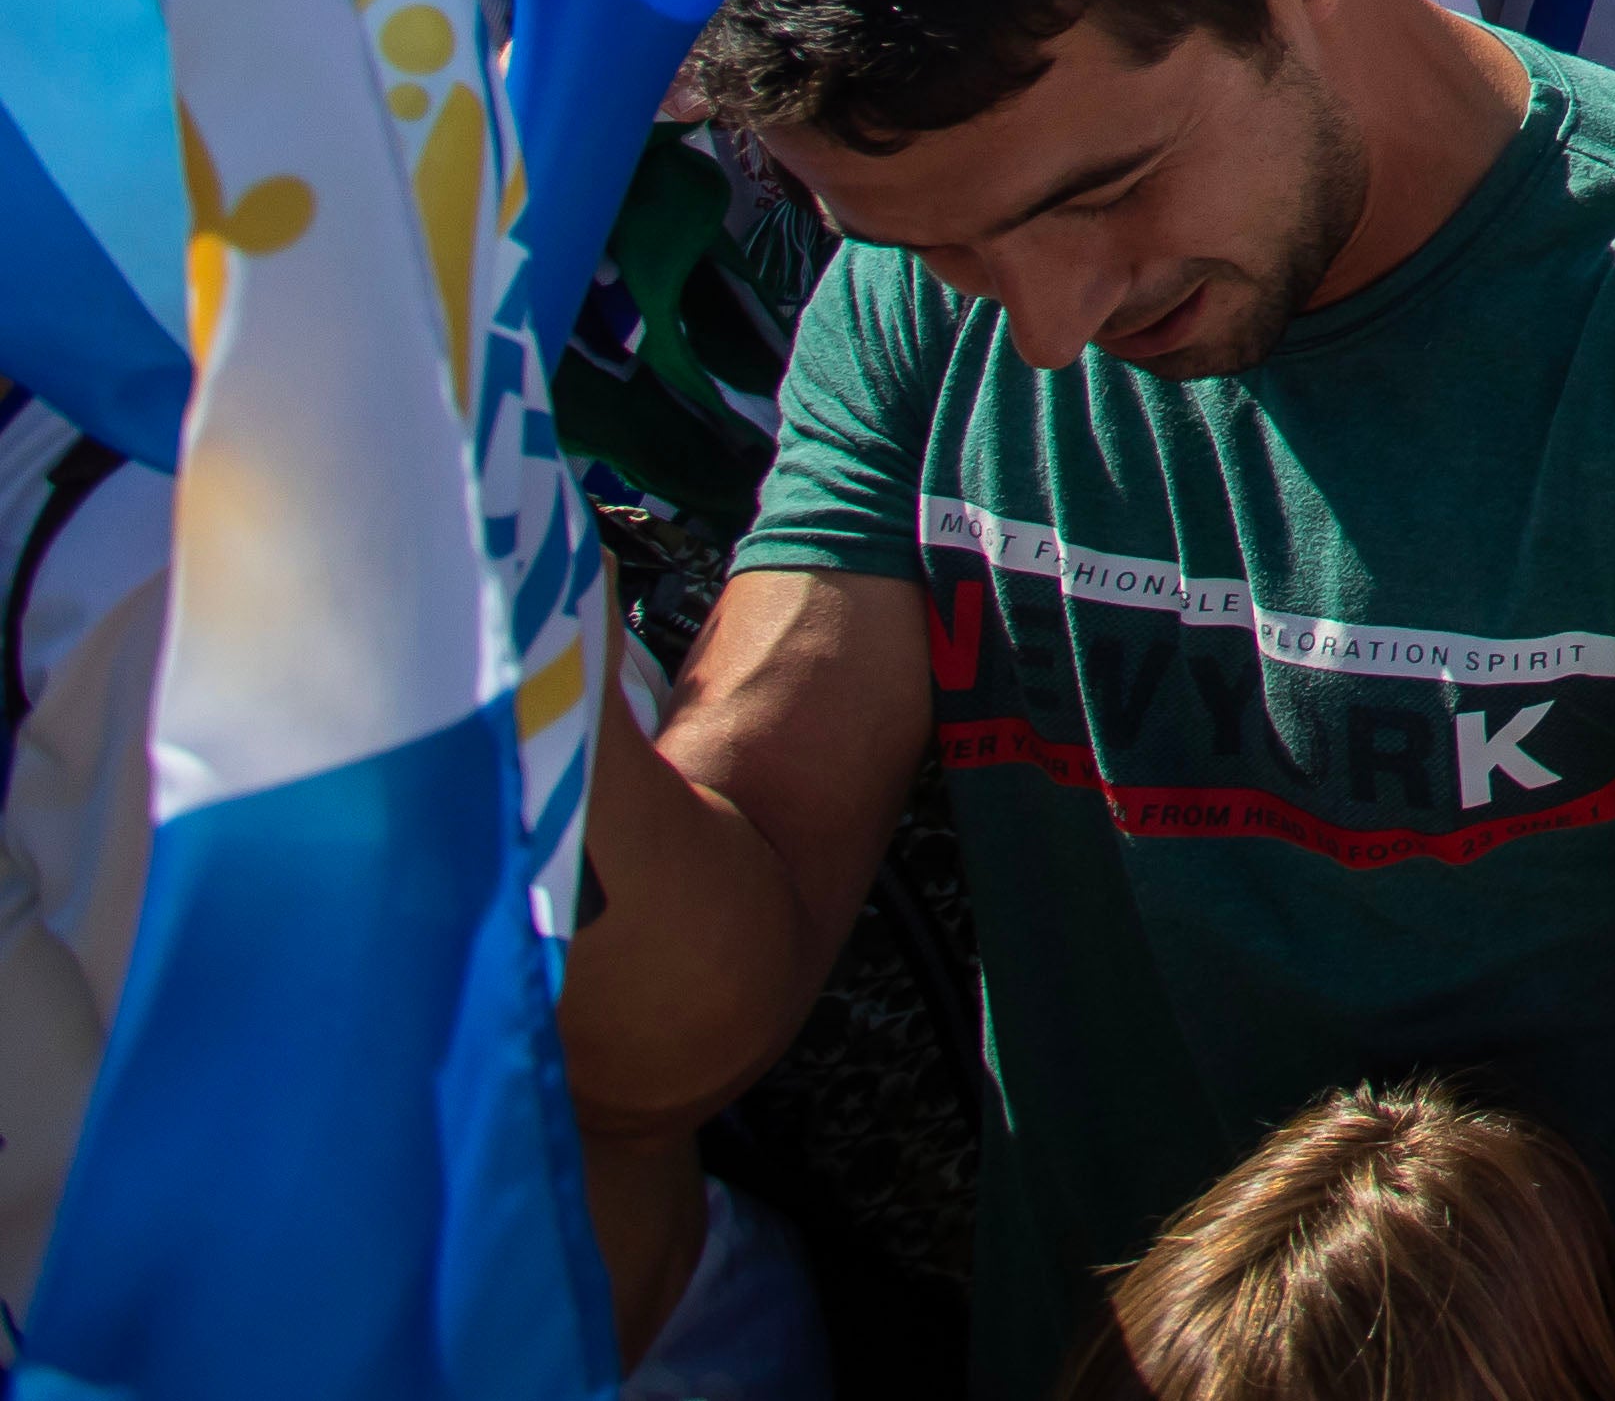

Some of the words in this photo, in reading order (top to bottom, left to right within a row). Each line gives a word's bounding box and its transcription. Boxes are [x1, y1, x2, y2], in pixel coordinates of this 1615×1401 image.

[940, 512, 1017, 555] MOST
[1260, 623, 1451, 666] PLORATION
[1465, 642, 1587, 673] SPIRIT
[939, 732, 998, 761] VER
[1139, 802, 1232, 828] FROM
